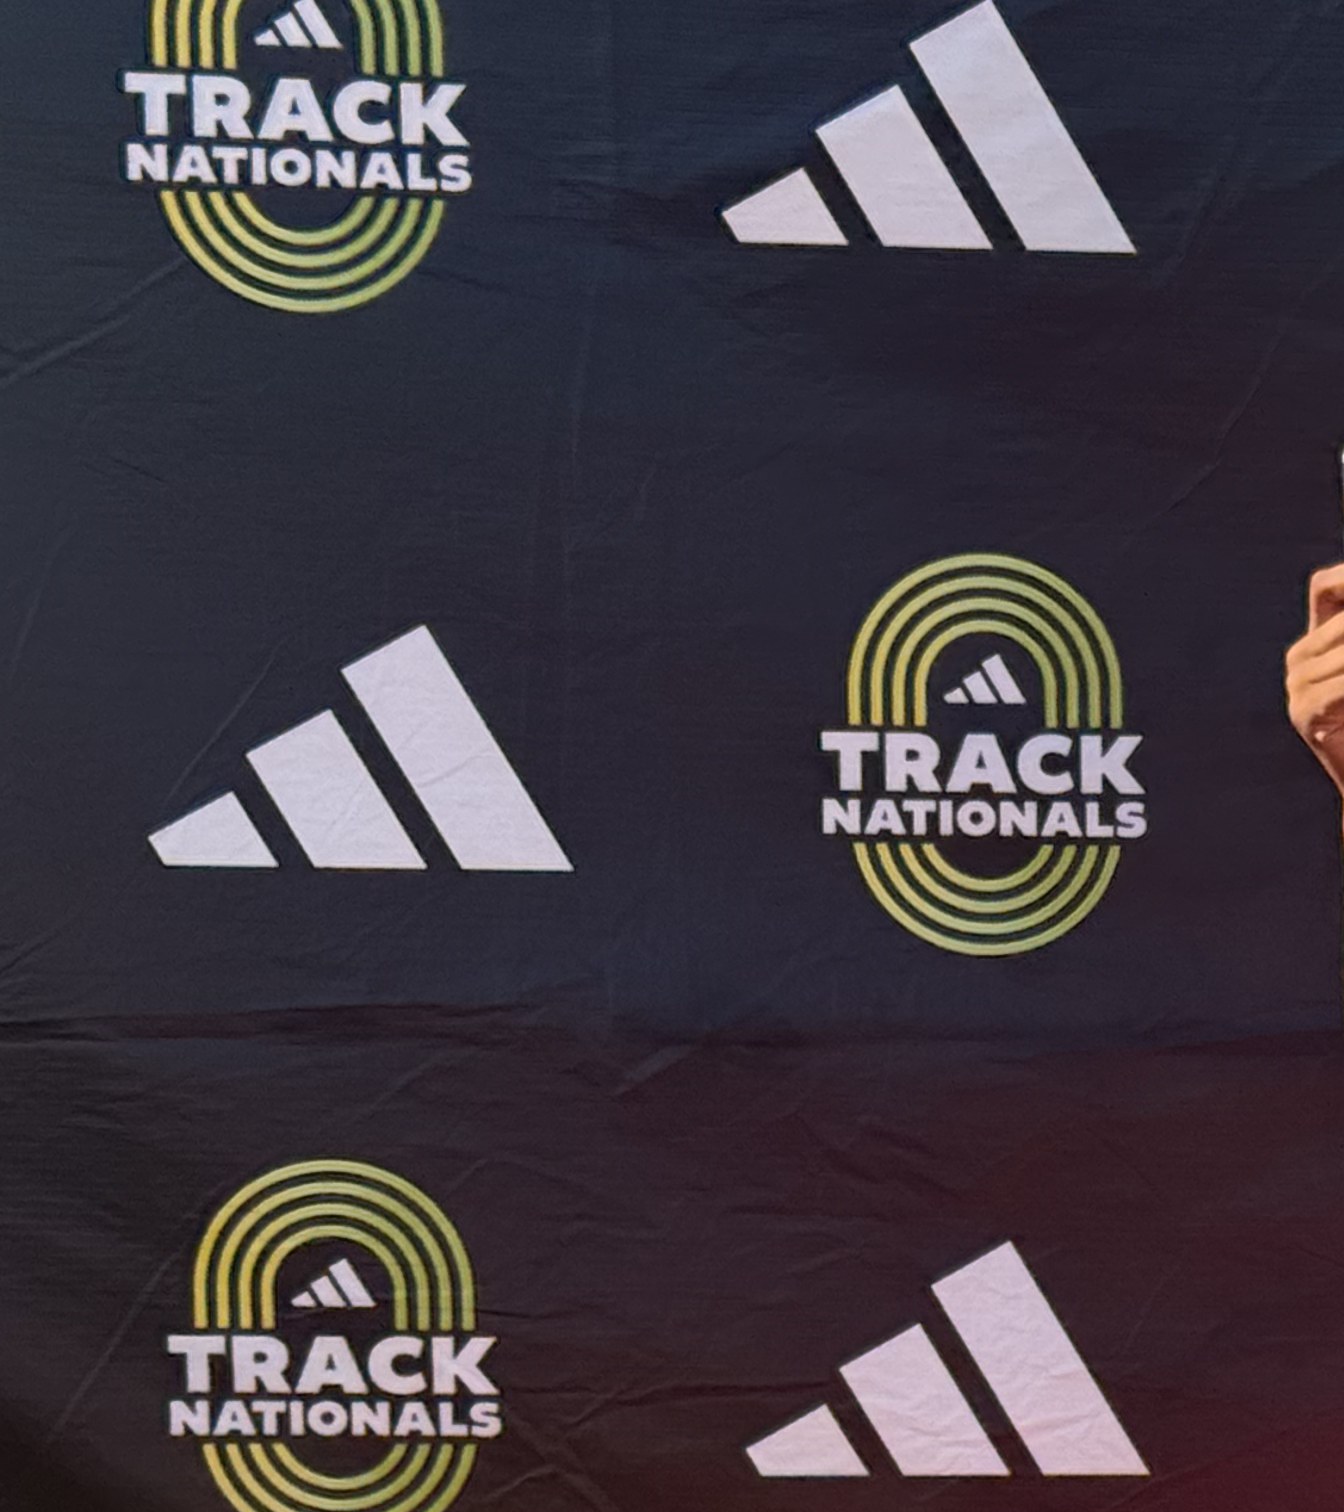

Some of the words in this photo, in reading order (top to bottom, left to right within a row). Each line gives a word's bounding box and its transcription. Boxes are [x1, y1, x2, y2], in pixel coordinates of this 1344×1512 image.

[125, 72, 469, 146] TRACK
[127, 143, 471, 192] NATIONALS
[821, 732, 1144, 794] TRACK
[823, 799, 1146, 837] NATIONALS
[168, 1335, 497, 1394] TRACK
[170, 1400, 501, 1436] NATIONALS
